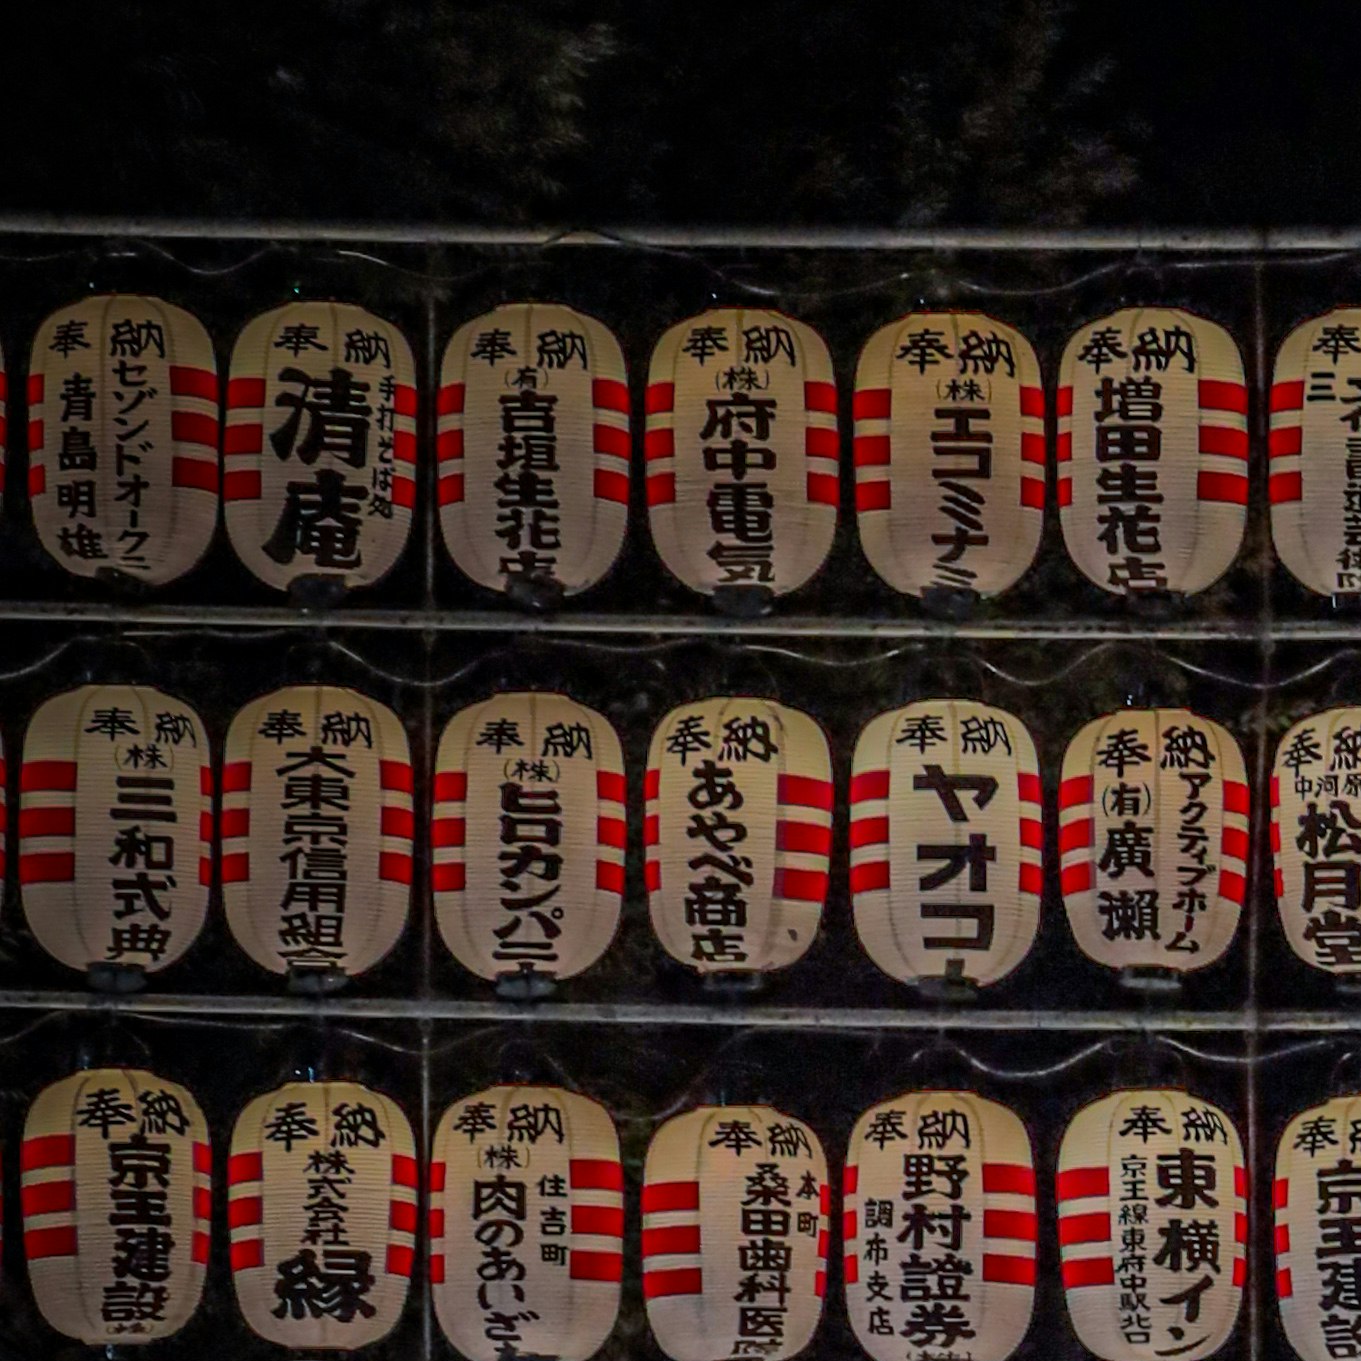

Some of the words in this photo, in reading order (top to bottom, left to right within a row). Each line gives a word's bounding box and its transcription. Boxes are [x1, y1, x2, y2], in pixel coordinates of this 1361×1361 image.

[50, 318, 163, 358] 奉納
[1078, 327, 1196, 373] 奉納
[57, 373, 107, 561] 青島明雄
[367, 374, 397, 518] 手打そば処
[698, 392, 777, 584] 府中電気
[85, 707, 195, 748] 奉納
[1097, 725, 1216, 778] 奉納
[107, 776, 178, 963] 三和式典
[683, 760, 755, 963] あやべ商店
[1166, 772, 1216, 954] アクティブホーム
[454, 1105, 564, 1144] 奉納
[101, 1133, 173, 1323] 京王建設
[303, 1150, 355, 1247] 株式会社
[538, 1175, 567, 1265] 住吉町
[798, 1171, 818, 1237] 本町
[1153, 1149, 1220, 1356] 東横イン
[275, 1249, 376, 1323] 縁
[864, 1199, 894, 1337] 調布支店
